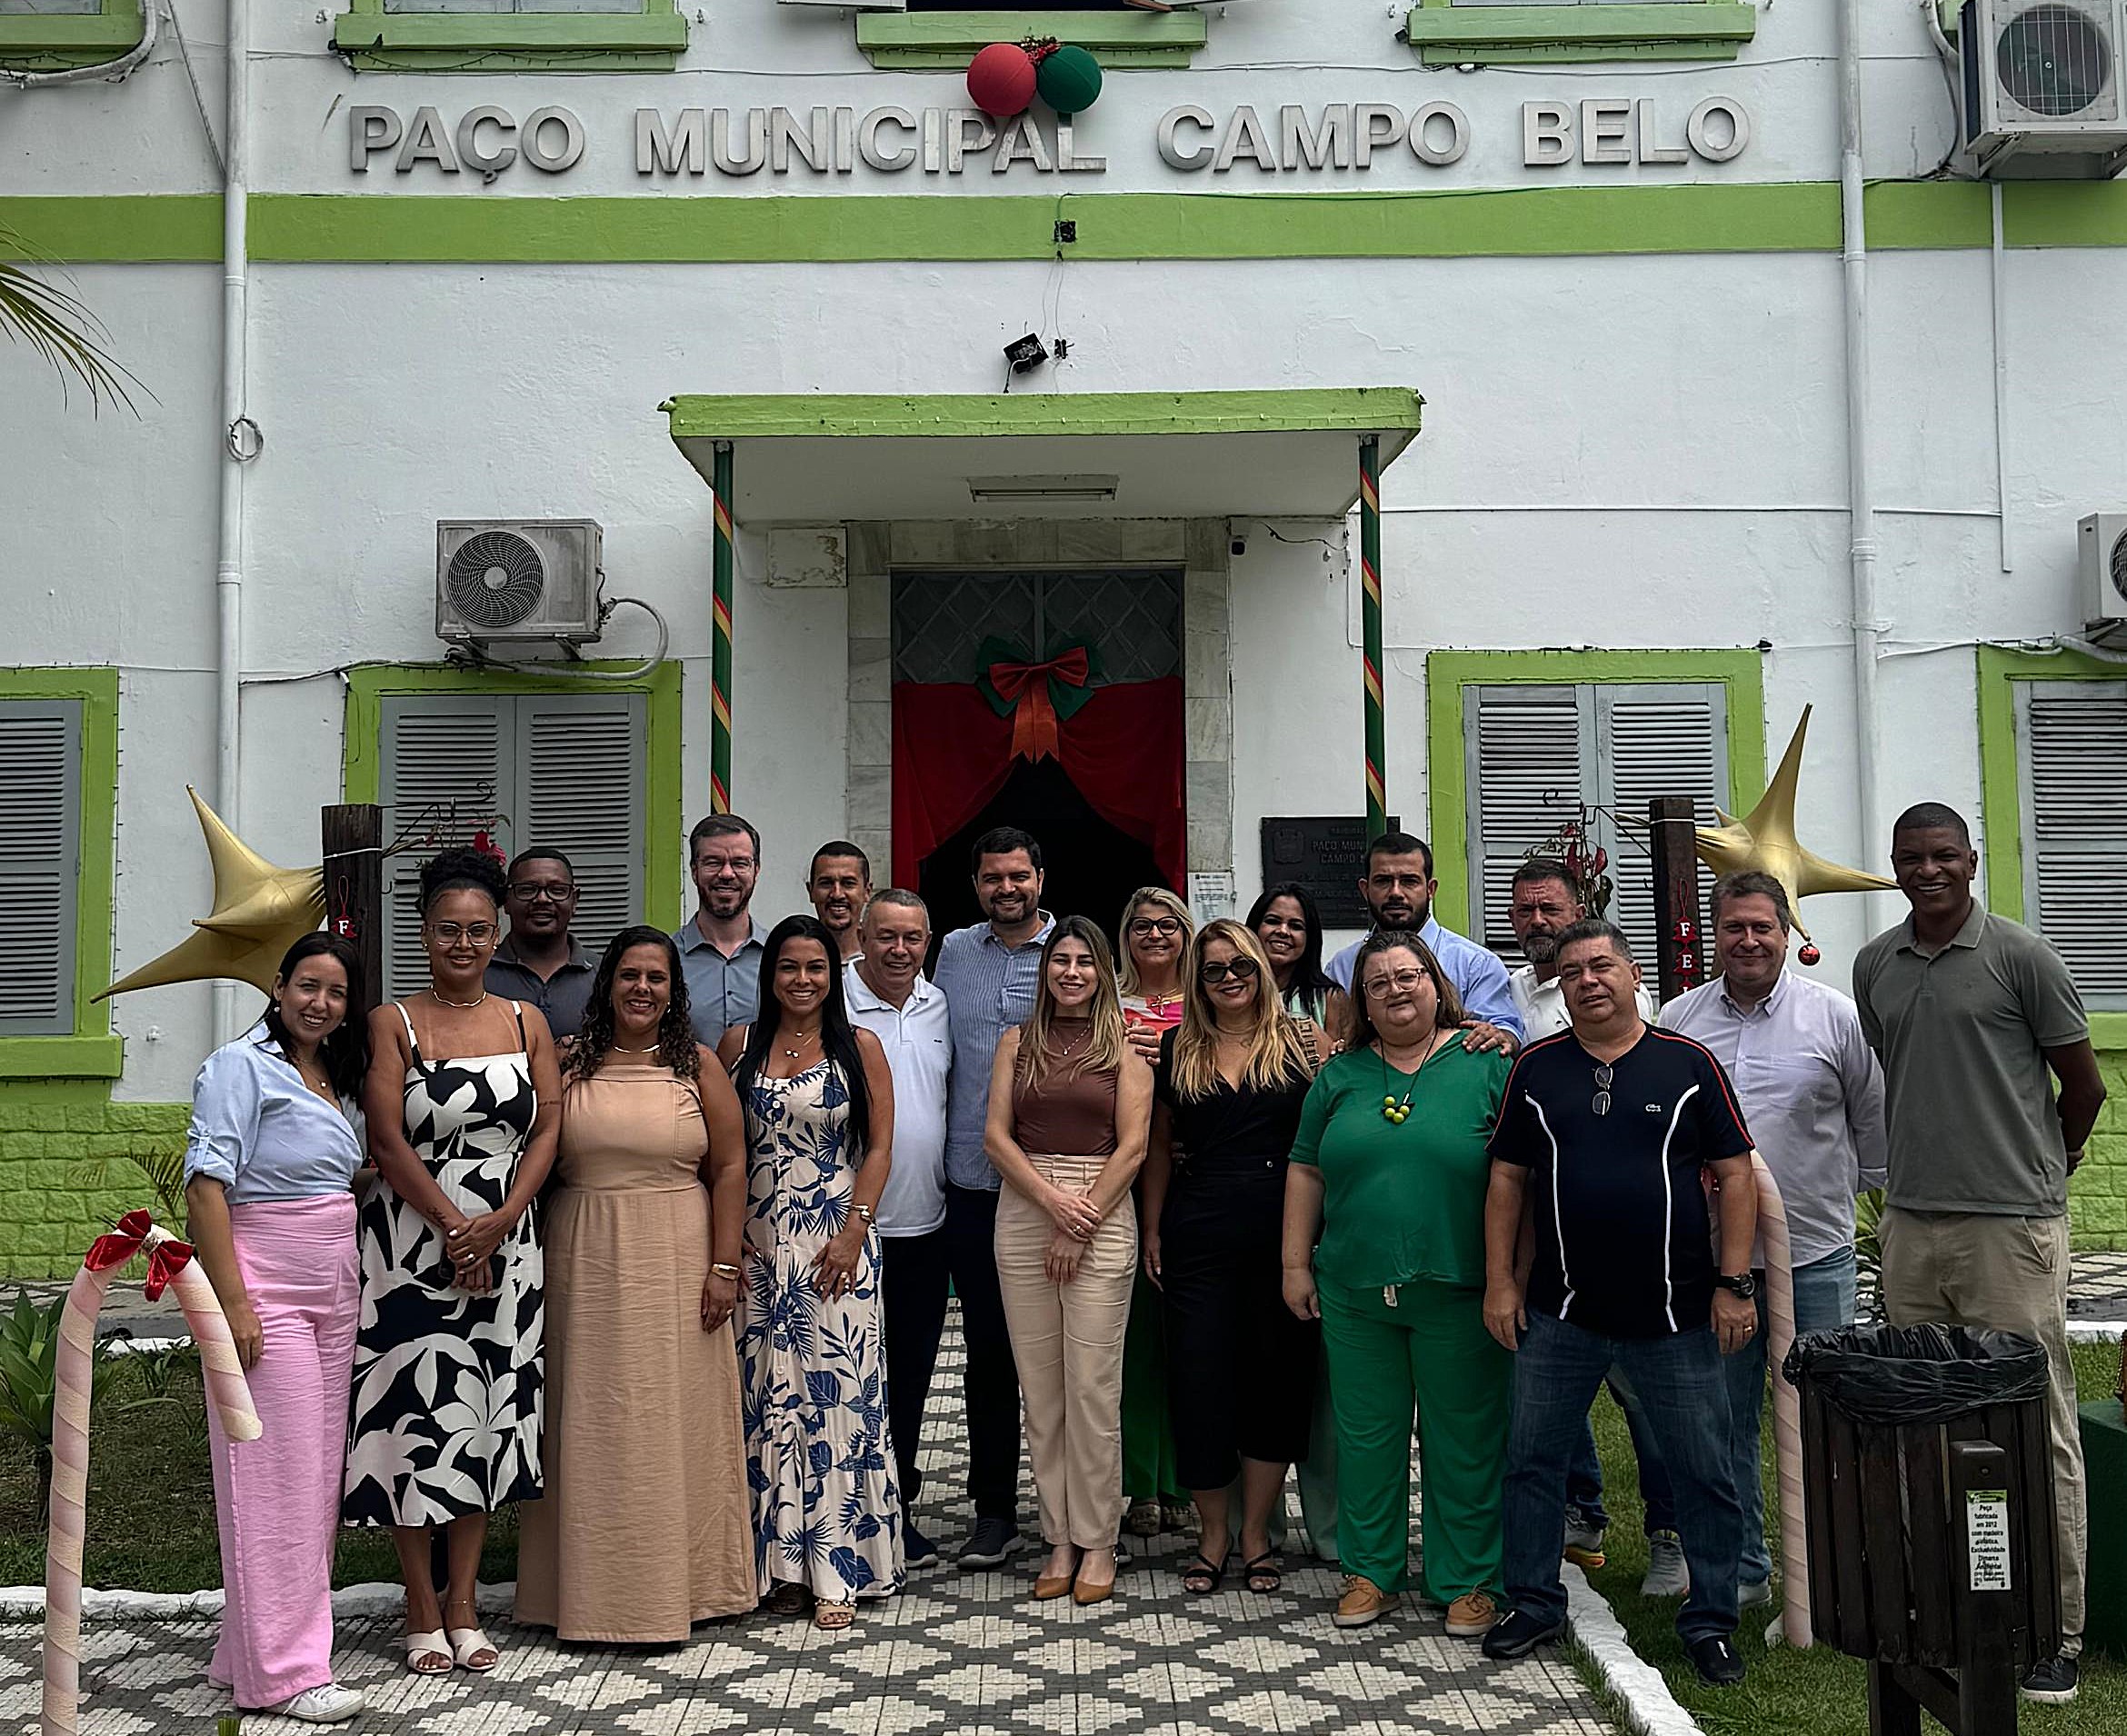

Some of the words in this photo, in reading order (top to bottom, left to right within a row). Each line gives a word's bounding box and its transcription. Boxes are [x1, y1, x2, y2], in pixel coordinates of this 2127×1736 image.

[348, 104, 584, 184] PAÇO
[634, 105, 1107, 175] MUNICIPAL
[1157, 101, 1471, 173] CAMPO
[1521, 95, 1751, 167] BELO
